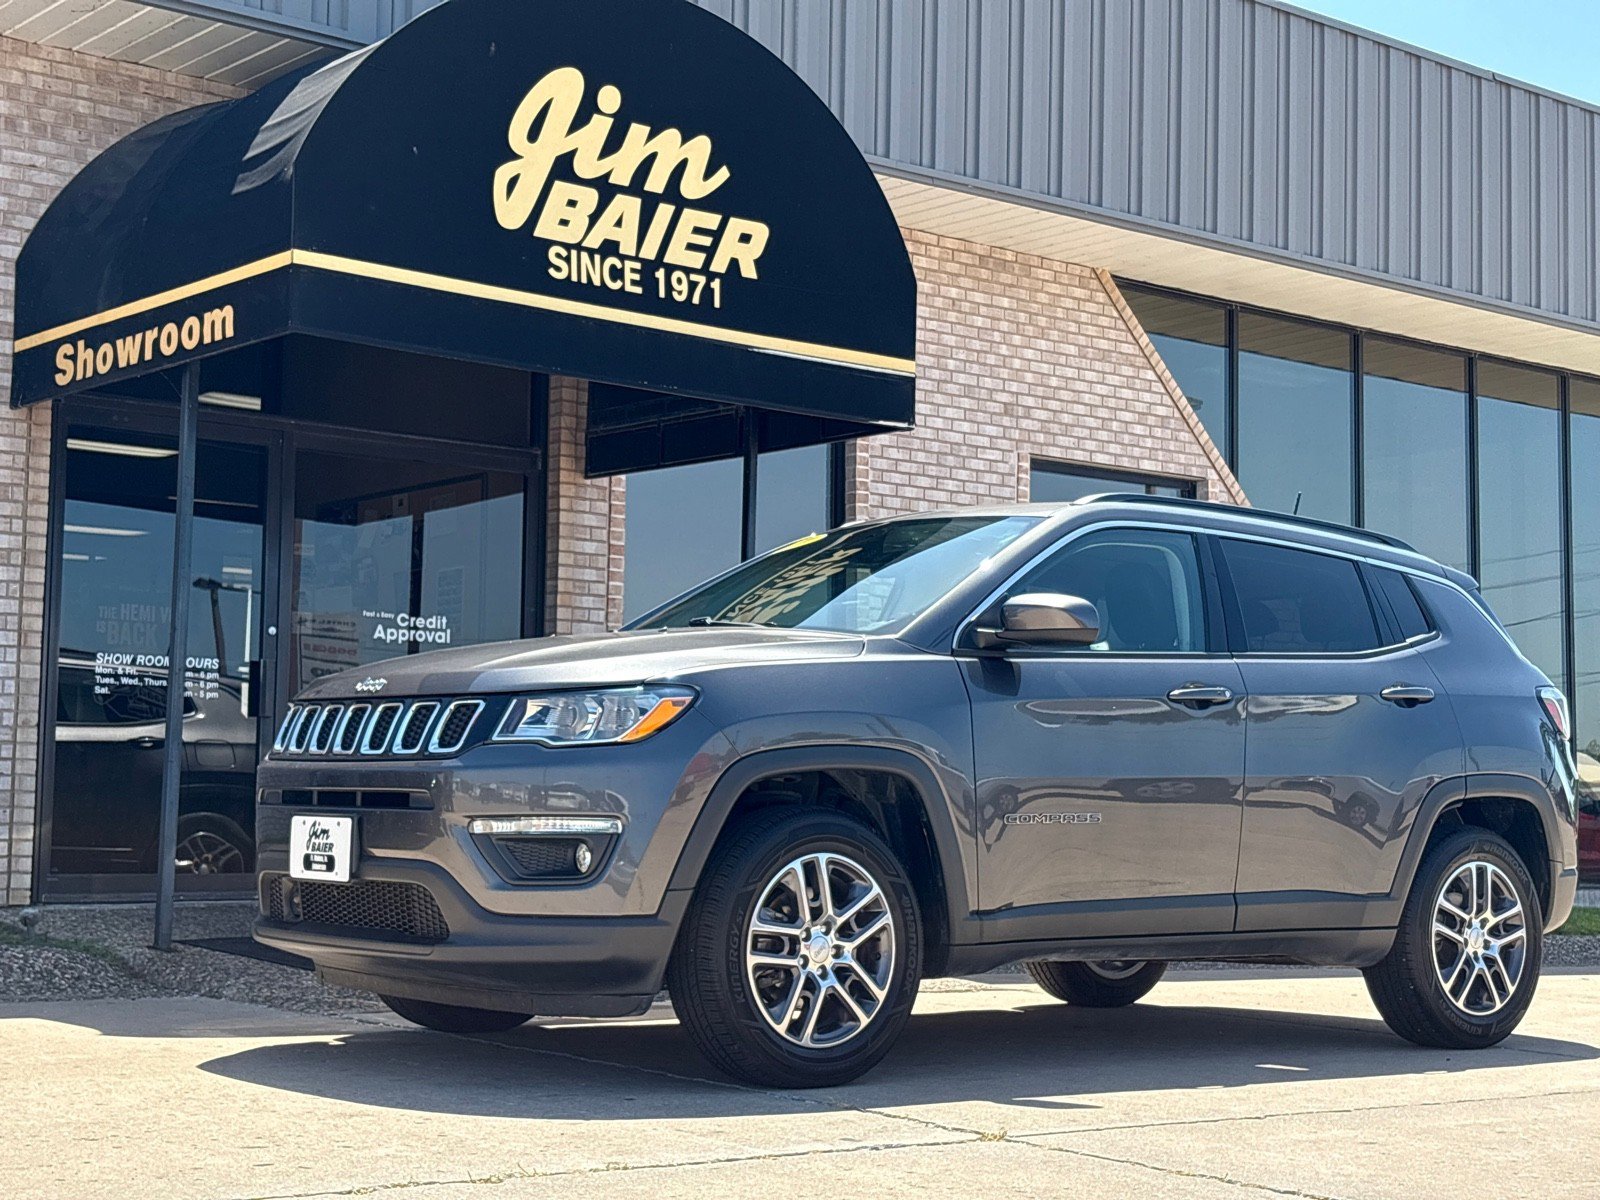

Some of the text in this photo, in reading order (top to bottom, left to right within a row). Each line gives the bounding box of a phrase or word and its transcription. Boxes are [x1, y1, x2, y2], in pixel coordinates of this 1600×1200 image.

[493, 66, 731, 230] Jim
[533, 180, 770, 280] BAIER
[548, 245, 721, 309] SINCE 1971
[54, 304, 235, 387] Showroom
[396, 612, 448, 630] Credit
[373, 624, 451, 644] Approval
[95, 652, 134, 665] SHOW
[186, 657, 220, 669] OURS
[95, 665, 115, 674] Mon.
[117, 667, 123, 675] &
[206, 672, 219, 680] pm
[94, 685, 111, 695] Sat.
[206, 692, 219, 700] pm
[206, 682, 219, 690] pm
[1003, 812, 1102, 825] COMPASS
[306, 820, 331, 851] Jim
[311, 842, 334, 853] BAIER
